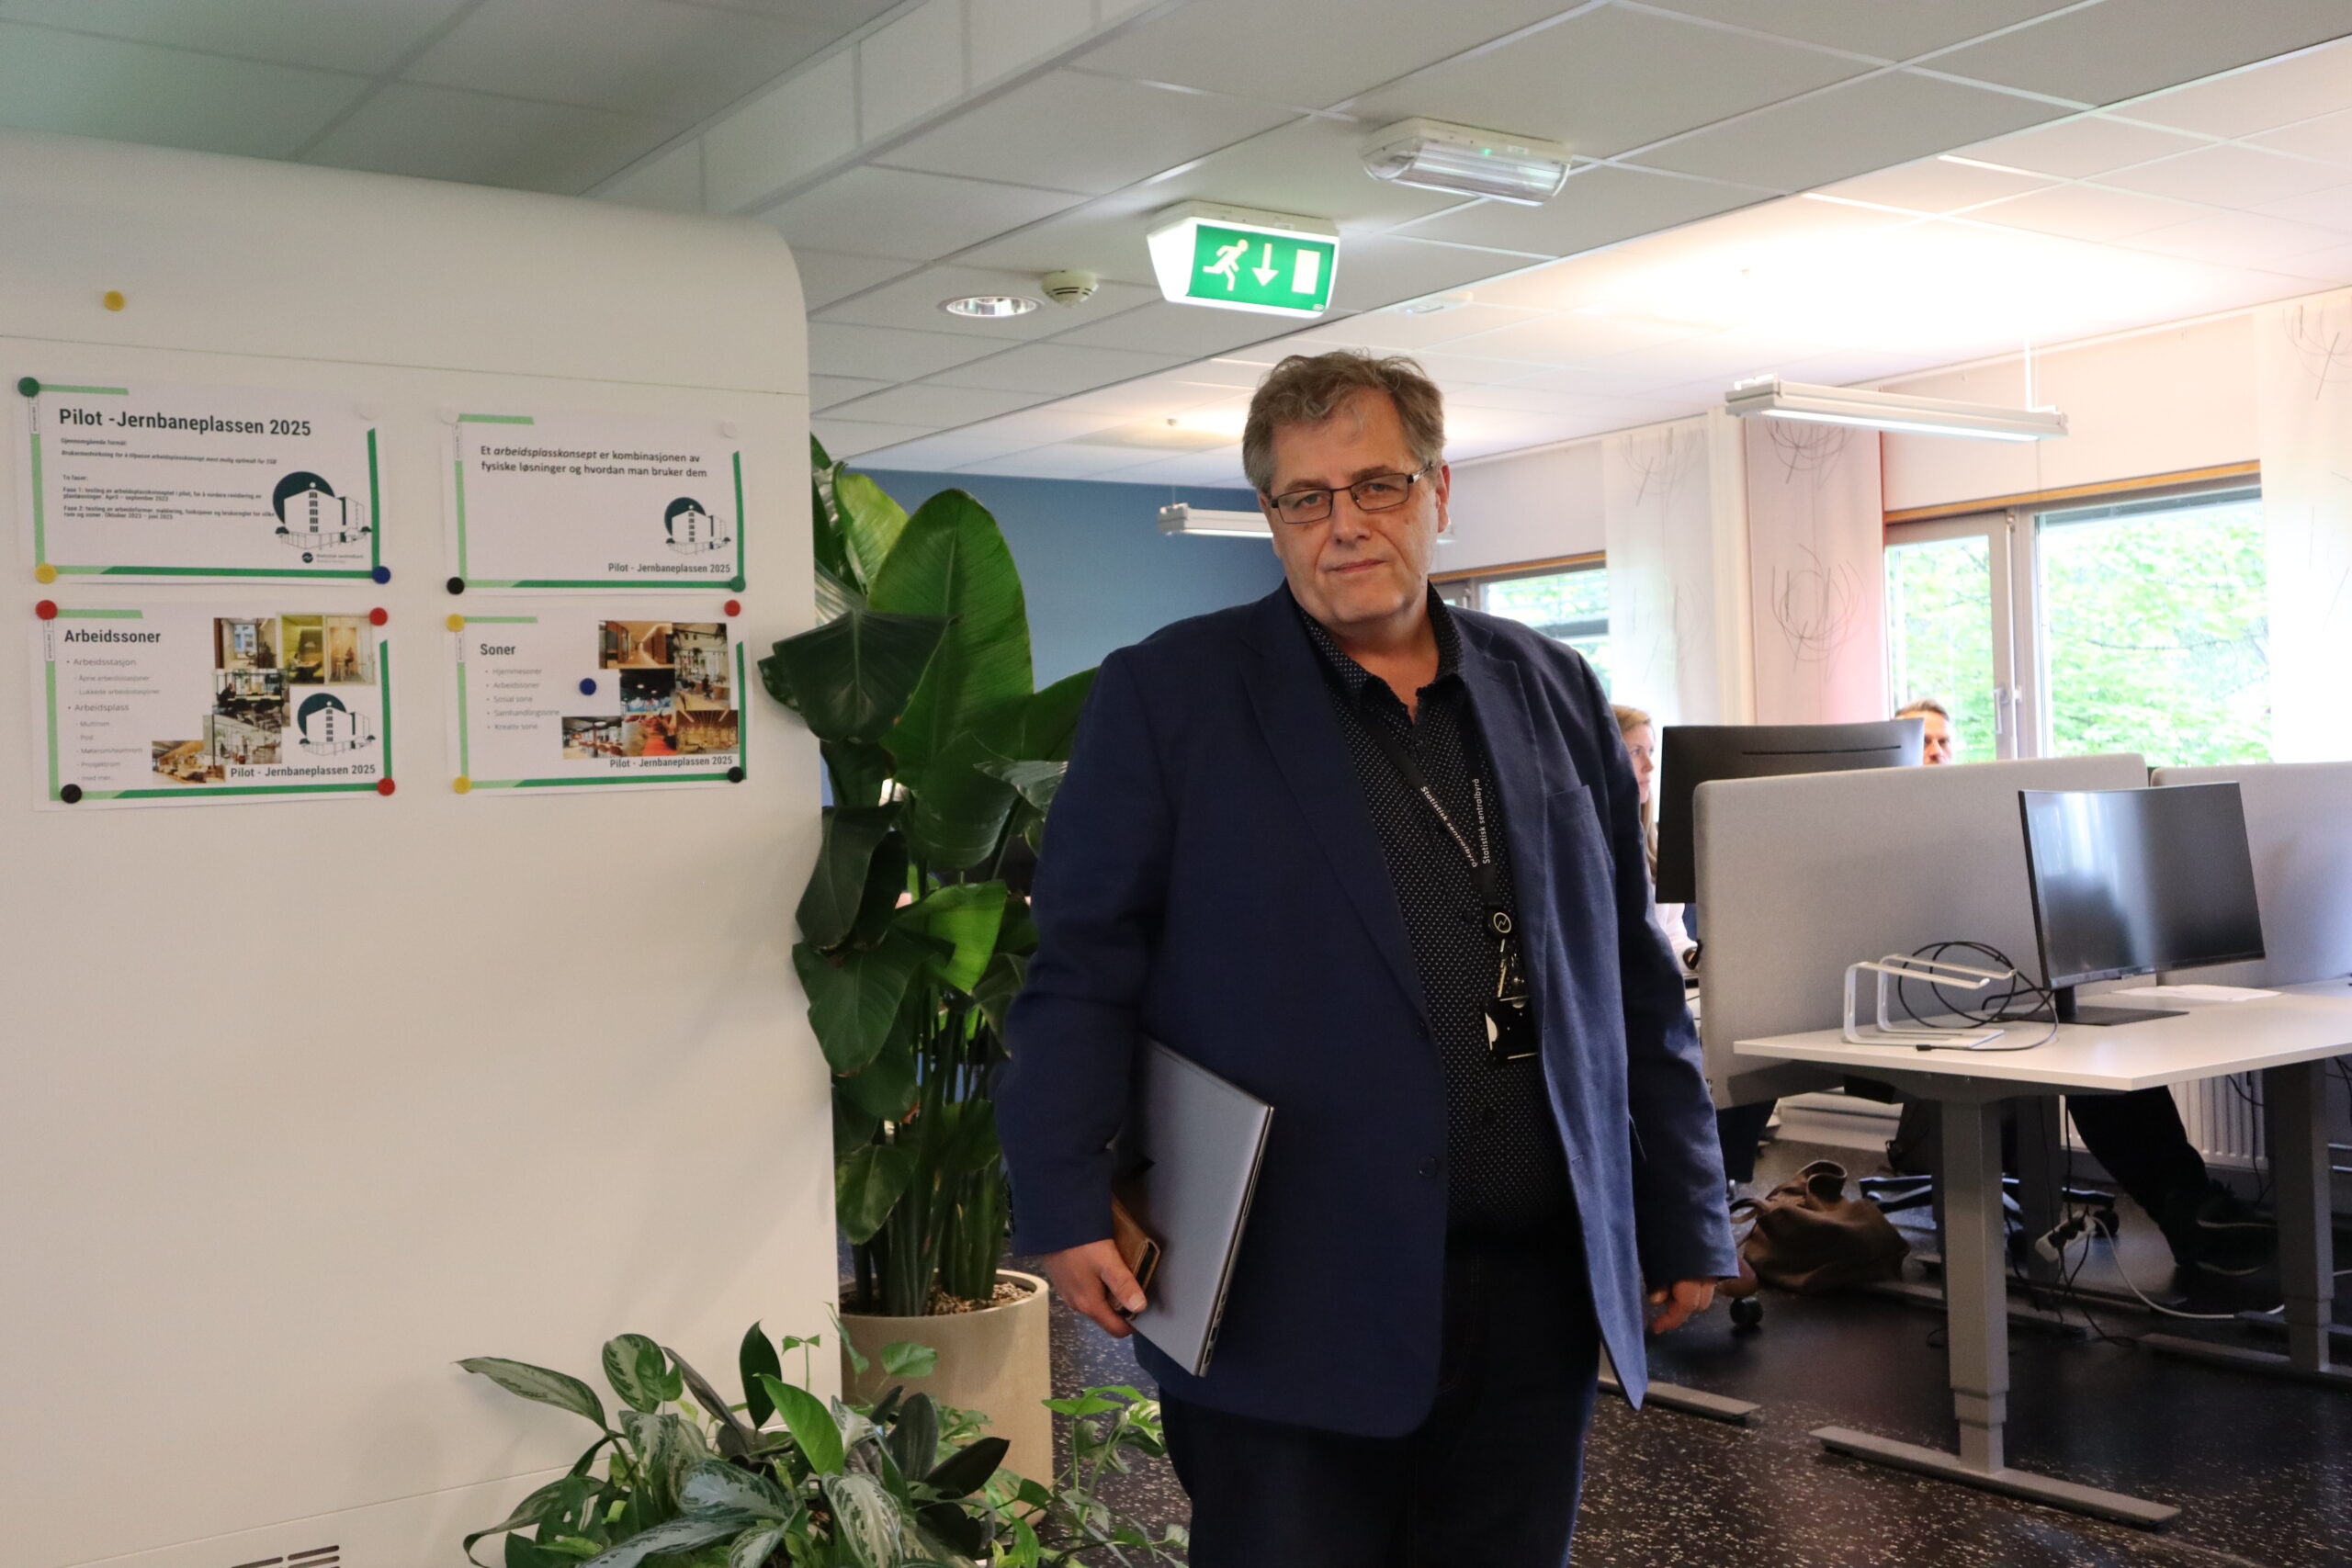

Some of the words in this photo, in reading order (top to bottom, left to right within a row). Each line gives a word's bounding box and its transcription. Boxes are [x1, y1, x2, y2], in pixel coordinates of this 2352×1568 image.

[59, 408, 103, 425] Pilot
[269, 419, 311, 436] 2025
[481, 446, 491, 456] Et
[493, 446, 597, 460] arbeidsplasskonsept
[612, 450, 686, 463] kombinasjonen
[481, 460, 516, 472] fysiske
[519, 462, 566, 475] løsninger
[569, 465, 581, 476] og
[584, 464, 625, 475] hvordan
[628, 468, 649, 476] man
[651, 467, 684, 477] bruker
[685, 468, 707, 478] dem
[608, 562, 628, 572] Pilot
[637, 563, 707, 575] Jernbaneplassen
[709, 564, 730, 573] 2025
[64, 628, 161, 643] Arbeidssoner
[480, 643, 516, 656] Soner
[74, 658, 137, 668] Arbeidsstasjon
[74, 704, 130, 713] Arbeidsplass
[610, 759, 630, 768] Pilot
[639, 757, 709, 768] Jernbaneplassen
[712, 756, 733, 765] 2025
[230, 767, 254, 777] Pilot
[265, 765, 349, 777] Jernbaneplassen
[351, 764, 376, 774] 2025
[1472, 778, 1486, 825] sentralbyrå
[1420, 786, 1448, 821] Statistisk
[1446, 822, 1479, 867] sentralbyrå
[1477, 826, 1490, 864] Statistisk
